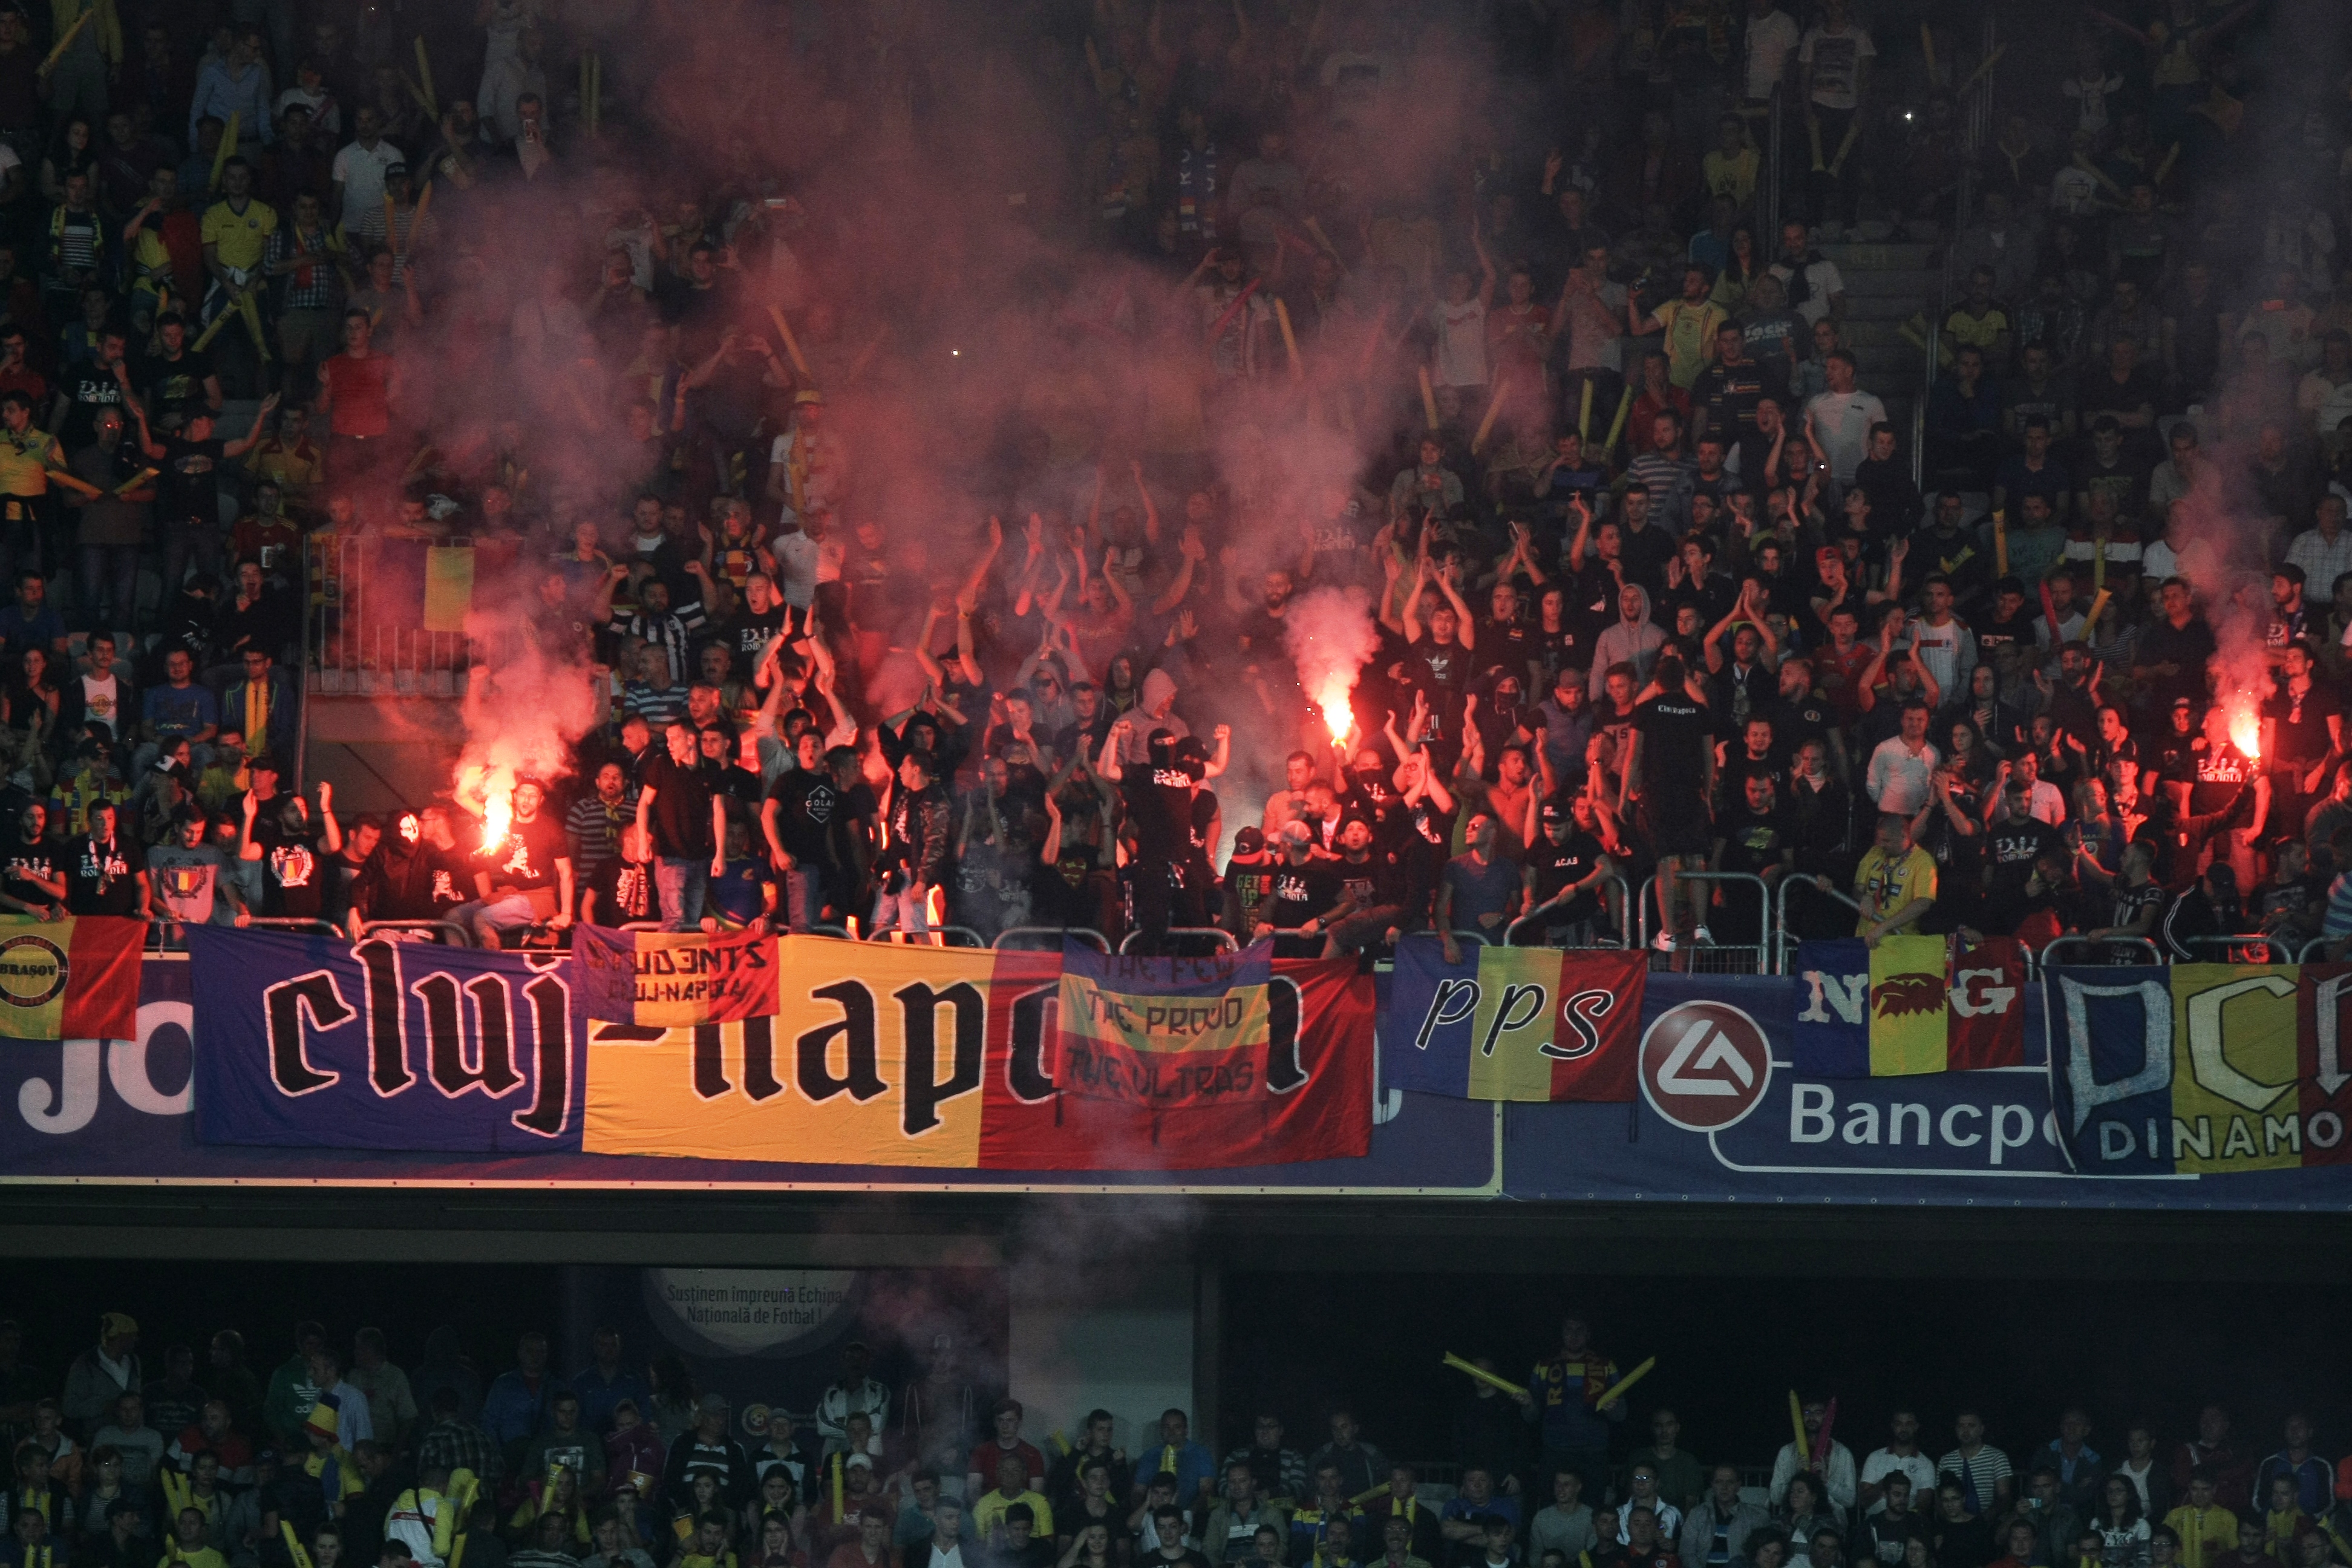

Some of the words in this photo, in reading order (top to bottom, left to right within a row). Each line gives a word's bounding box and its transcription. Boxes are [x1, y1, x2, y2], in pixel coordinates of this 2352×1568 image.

[1146, 998, 1242, 1035] PROUD
[1789, 1083, 2057, 1165] Bancp
[2099, 1111, 2344, 1161] DINAMO
[799, 1286, 842, 1307] Echipa
[754, 1307, 770, 1324] de
[773, 1307, 815, 1325] Fotbal
